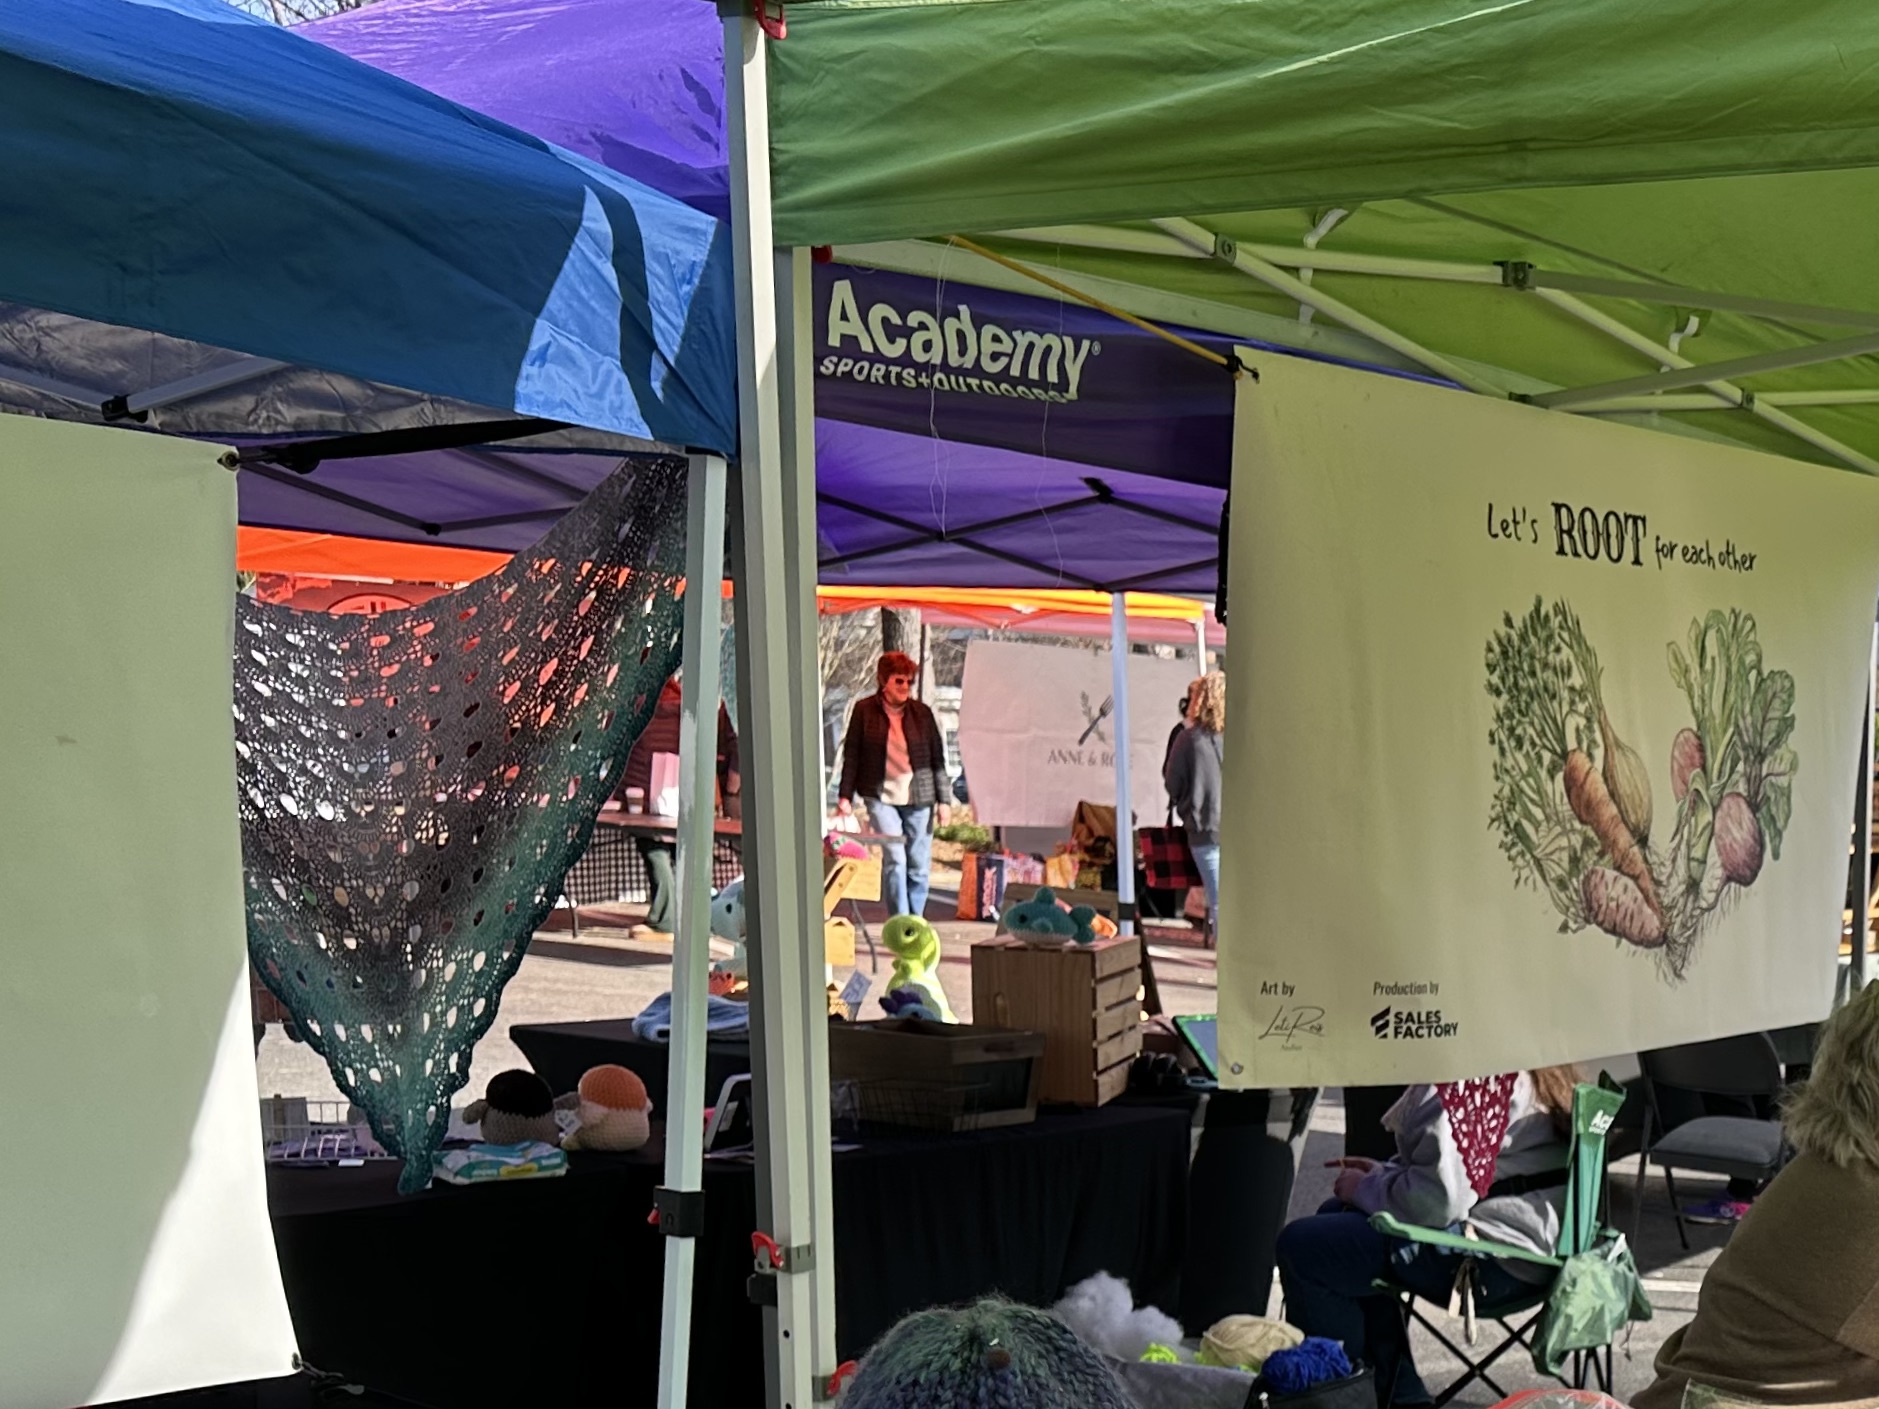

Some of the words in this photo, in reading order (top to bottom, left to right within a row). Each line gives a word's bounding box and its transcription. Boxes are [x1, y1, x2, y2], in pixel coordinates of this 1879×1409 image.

[1487, 502, 1539, 544] Let's
[1551, 501, 1647, 567] ROOT
[1655, 535, 1679, 570] for
[1682, 539, 1716, 570] each
[1719, 538, 1757, 573] other
[1260, 981, 1278, 995] Art
[1281, 981, 1295, 997] by
[1373, 981, 1427, 996] Production
[1429, 981, 1439, 996] by
[1393, 1010, 1441, 1025] SALES
[1393, 1022, 1458, 1039] FACTORY
